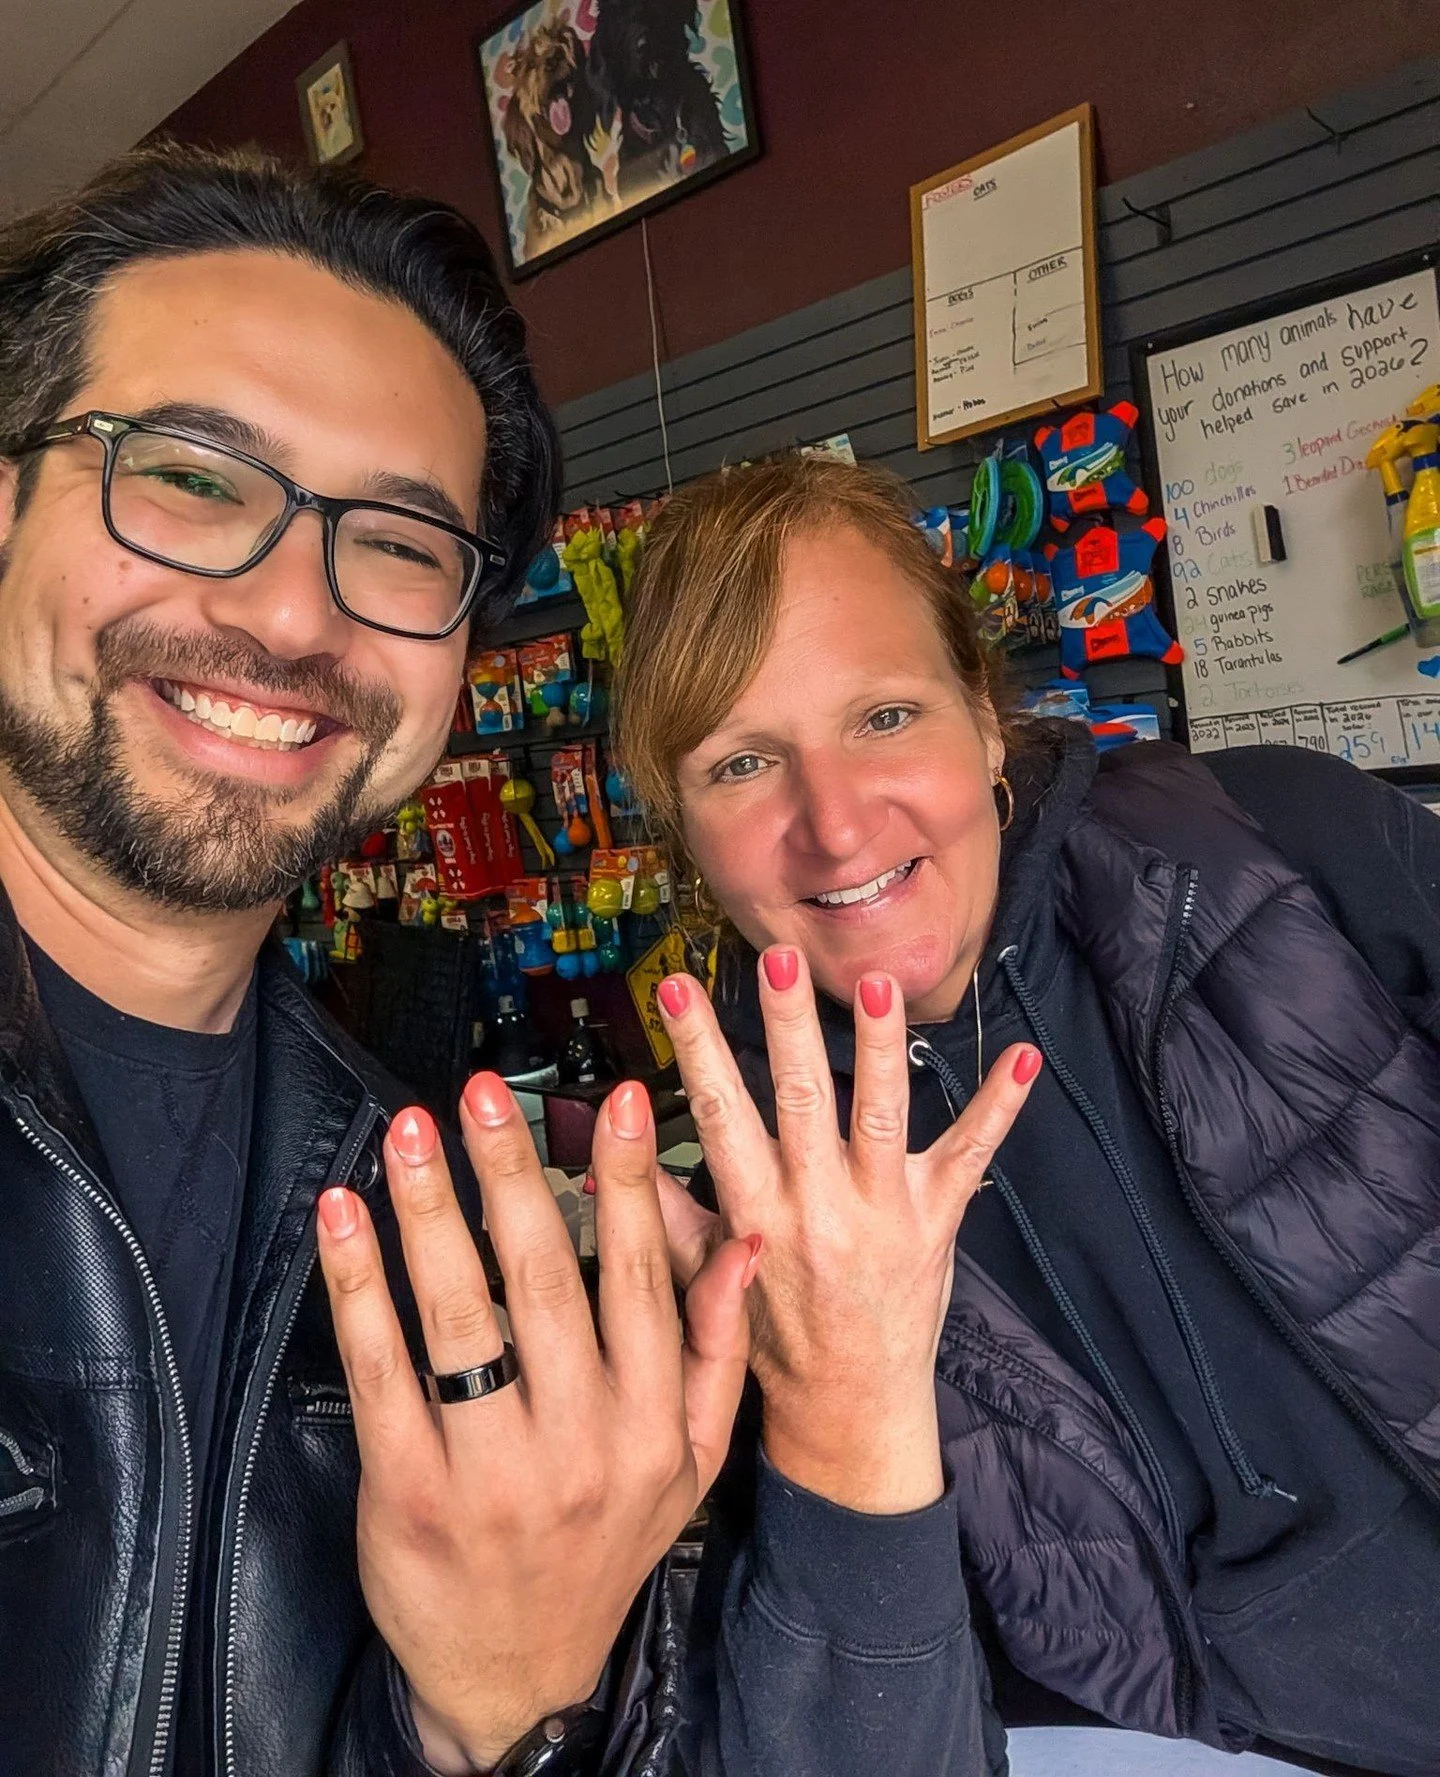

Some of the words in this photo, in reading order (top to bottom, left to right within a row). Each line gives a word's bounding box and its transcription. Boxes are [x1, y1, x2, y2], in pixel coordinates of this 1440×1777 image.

[1028, 256, 1067, 281] OTHER
[1161, 359, 1204, 393] How
[1220, 331, 1271, 372] many
[1279, 307, 1337, 345] animals
[1346, 291, 1419, 331] have
[1157, 400, 1195, 442] your
[1211, 372, 1287, 413] donations
[1299, 352, 1329, 379] and
[1200, 408, 1253, 439] helped
[1322, 381, 1340, 395] in
[1282, 442, 1297, 464] 3
[1165, 479, 1195, 503] 100
[1282, 475, 1294, 495] 1
[1174, 508, 1190, 530] 4
[1172, 535, 1184, 556] 8
[1195, 521, 1236, 546] Birds
[1172, 559, 1202, 583] 92
[1186, 587, 1199, 609] 2
[1209, 609, 1246, 633] guinea
[1249, 602, 1275, 625] pigs
[1194, 637, 1207, 656] 5
[1211, 628, 1274, 652] Rabbits
[1194, 660, 1209, 679] 18
[1213, 649, 1283, 675] Tarantulas
[1191, 727, 1220, 742] 2022
[1297, 735, 1326, 751] 790
